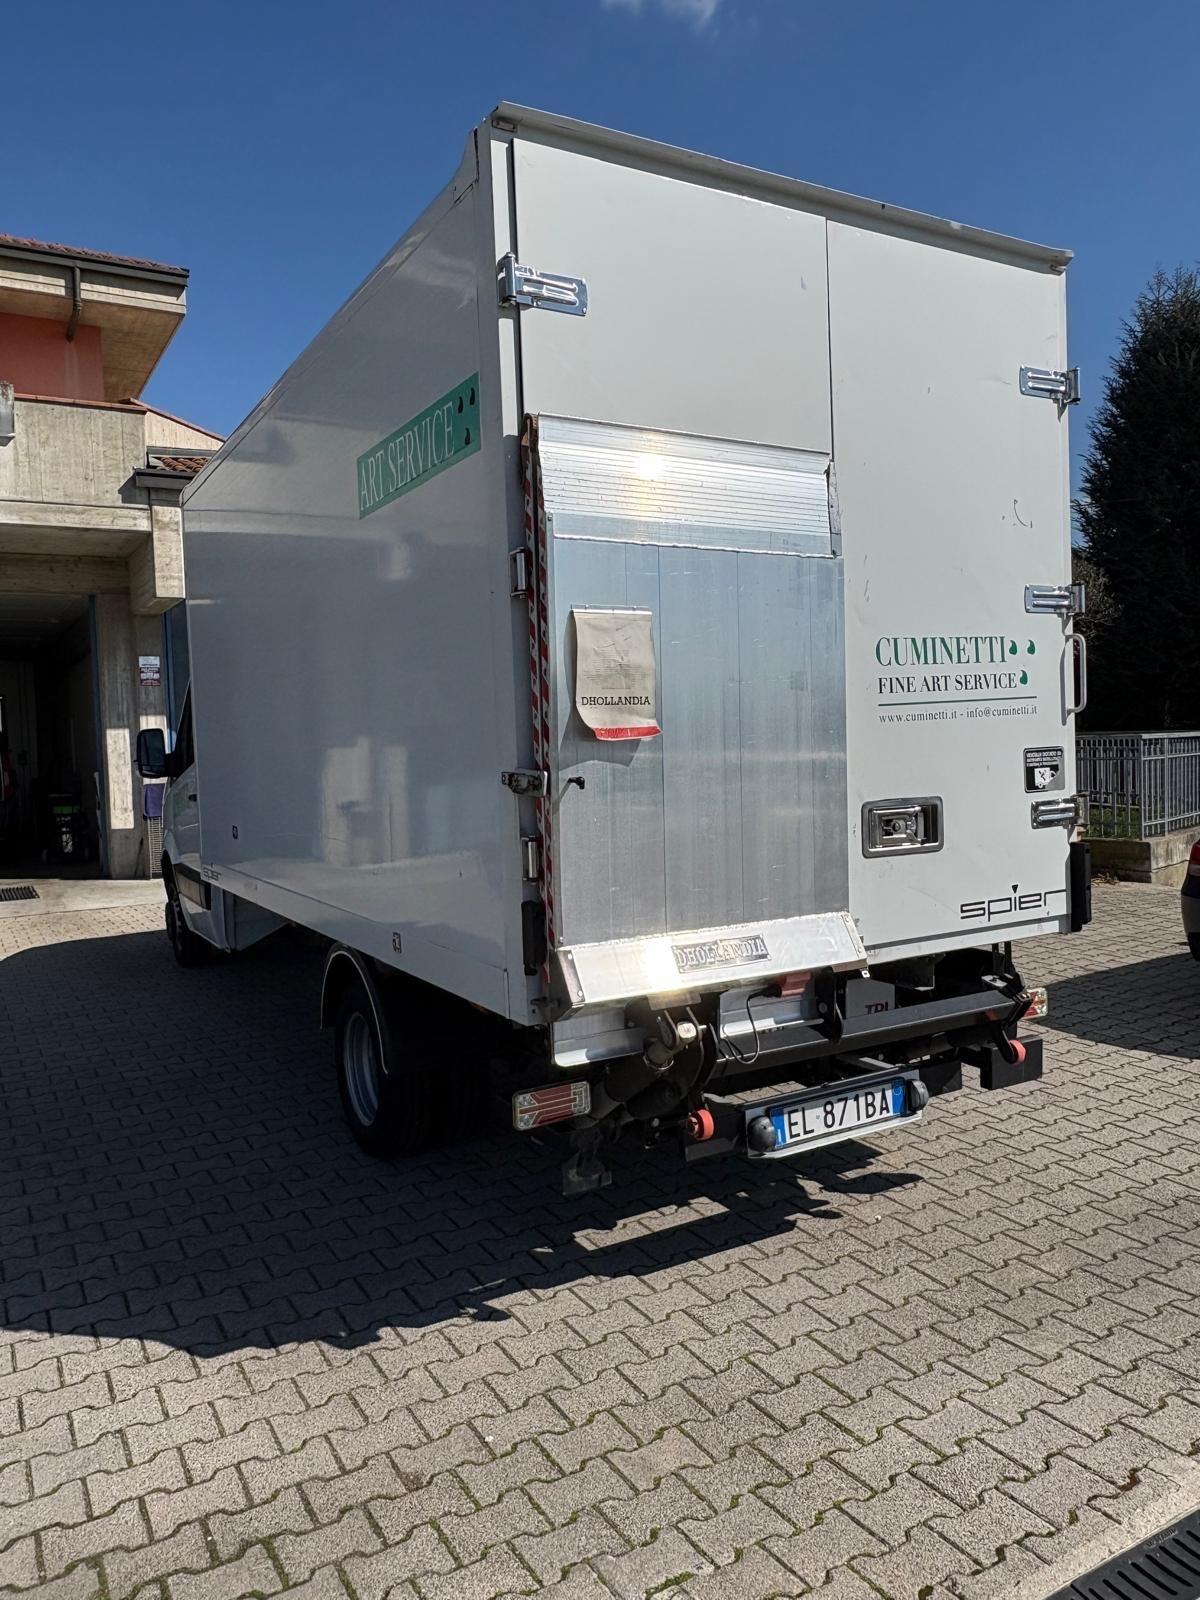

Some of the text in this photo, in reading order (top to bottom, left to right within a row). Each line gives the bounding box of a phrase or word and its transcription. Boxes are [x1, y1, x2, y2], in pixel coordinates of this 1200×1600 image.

[360, 401, 454, 511] ART SERVICE
[875, 635, 1008, 667] CUMINETTI
[878, 672, 1017, 694] FINE ART SERVICE
[581, 696, 651, 706] DHOLLANDIA
[878, 709, 958, 723] www.cuminetti.it
[966, 705, 1038, 718] info@cuminetti.it
[960, 884, 1067, 922] spier
[676, 938, 768, 967] DHOLLANDIA
[788, 1087, 891, 1140] EL 871BA
